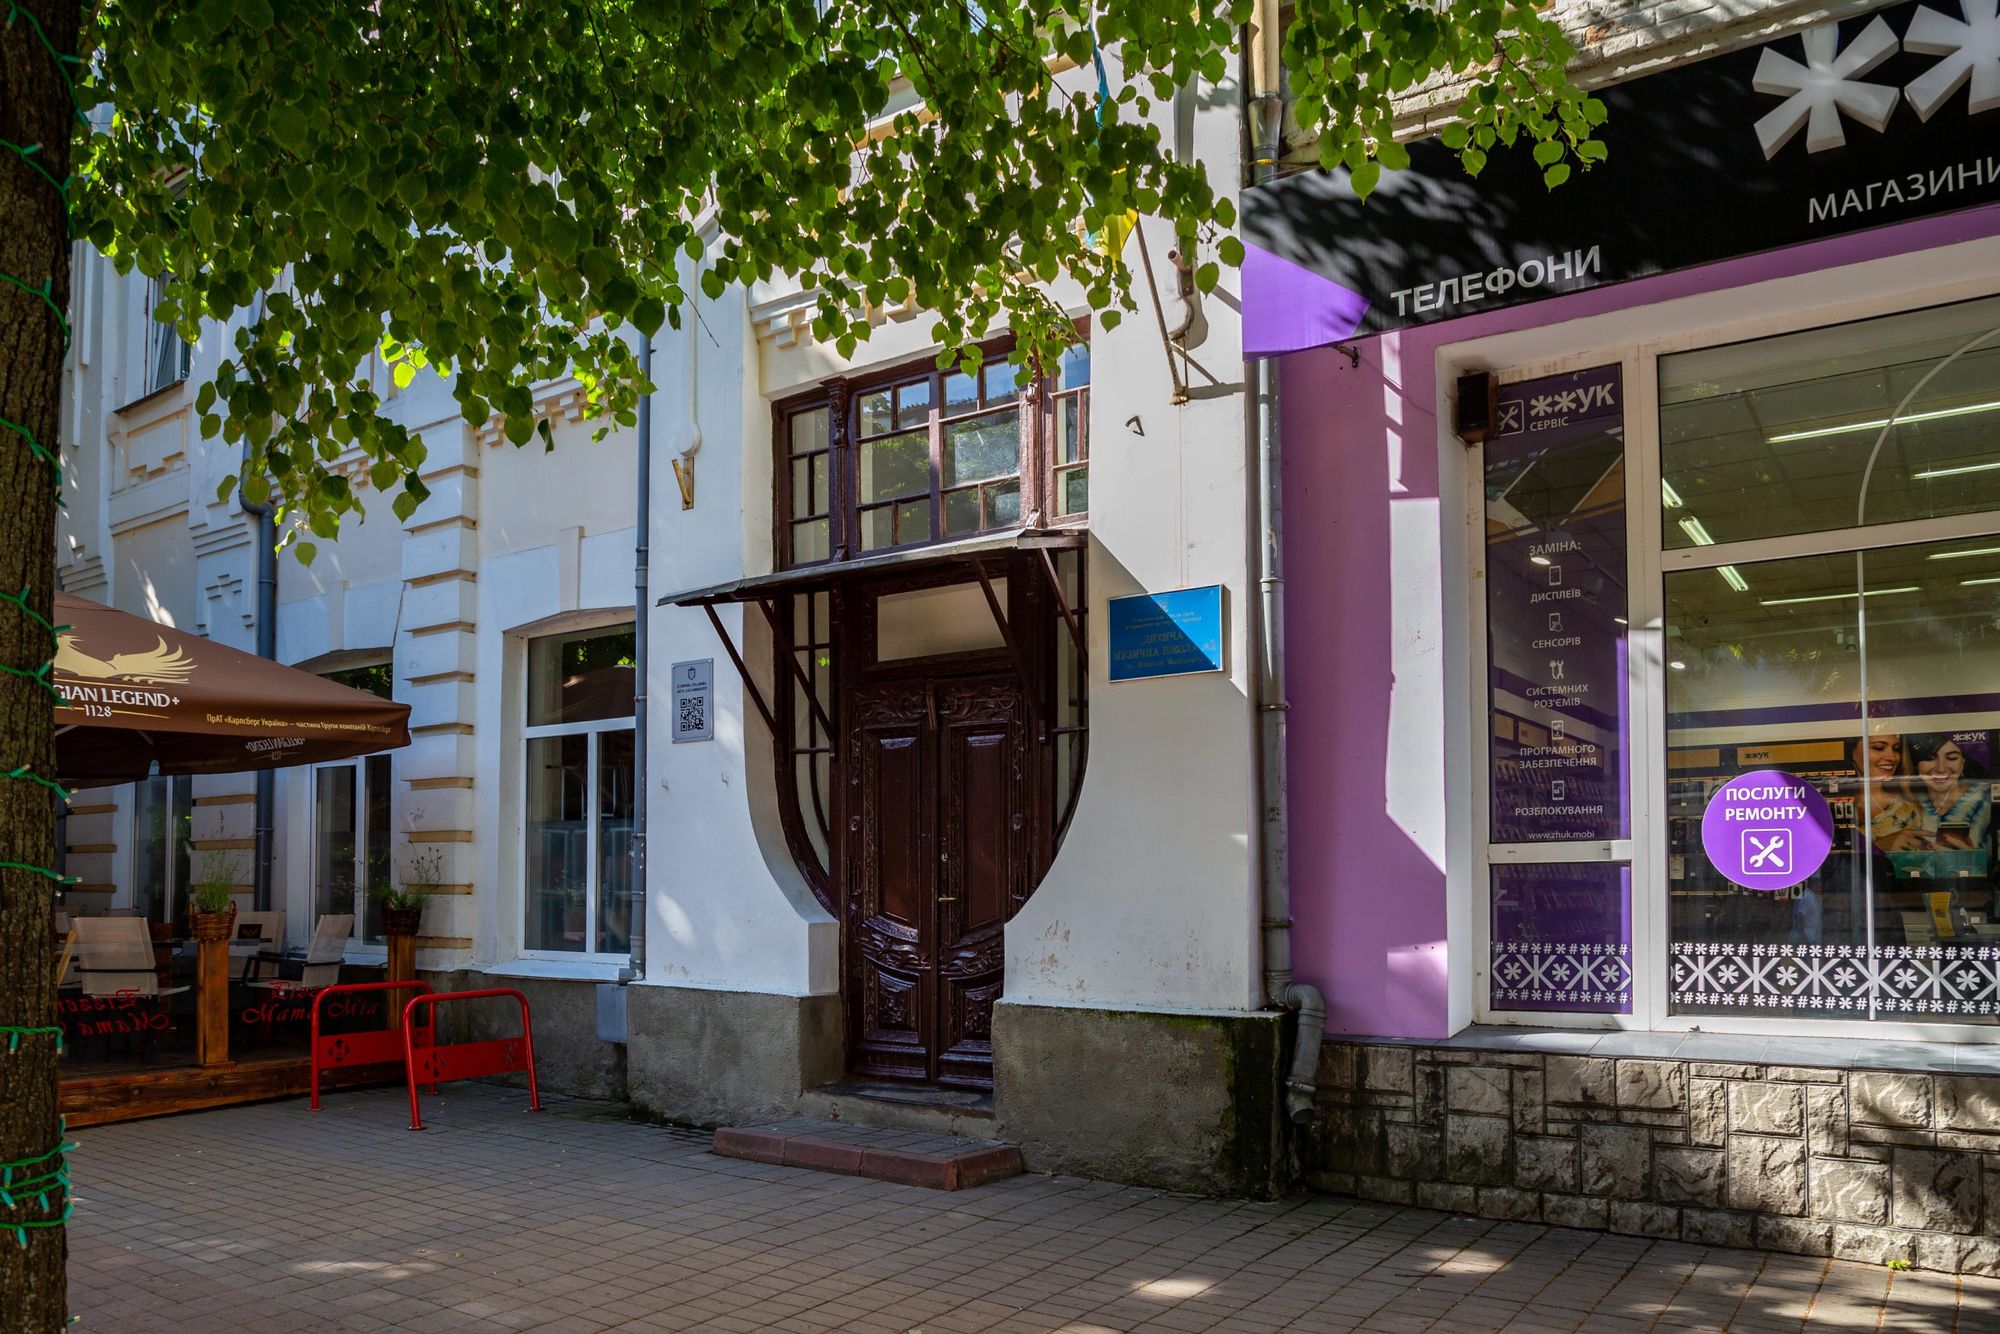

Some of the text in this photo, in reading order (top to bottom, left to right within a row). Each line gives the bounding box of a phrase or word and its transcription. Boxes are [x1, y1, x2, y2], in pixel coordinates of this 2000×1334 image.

[1390, 245, 1601, 316] ТЕЛЕФОНИ
[1530, 417, 1569, 431] СЕРВІС
[1529, 540, 1581, 555] ЗАМІНА:
[1530, 588, 1581, 604] ДИСПЛЕЇВ
[1532, 637, 1581, 649] СЕНСОРІВ
[53, 684, 98, 702] GIAN
[1526, 684, 1589, 696] СИСТЕМНИХ
[1534, 697, 1581, 708] РОЗ'ЄМІВ
[84, 704, 112, 717] 1128
[206, 713, 224, 724] ПрАТ
[1520, 744, 1596, 756] ПРОГРАМНОГО
[1519, 757, 1597, 769] ЗАБЕЗПЕЧЕННЯ
[1725, 786, 1806, 802] ПОСЛУГИ
[1515, 805, 1603, 816] РОЗБЛОКУВАННЯ
[1725, 806, 1807, 821] РЕМОНТУ
[1528, 830, 1595, 839] www.zhuk.mobi
